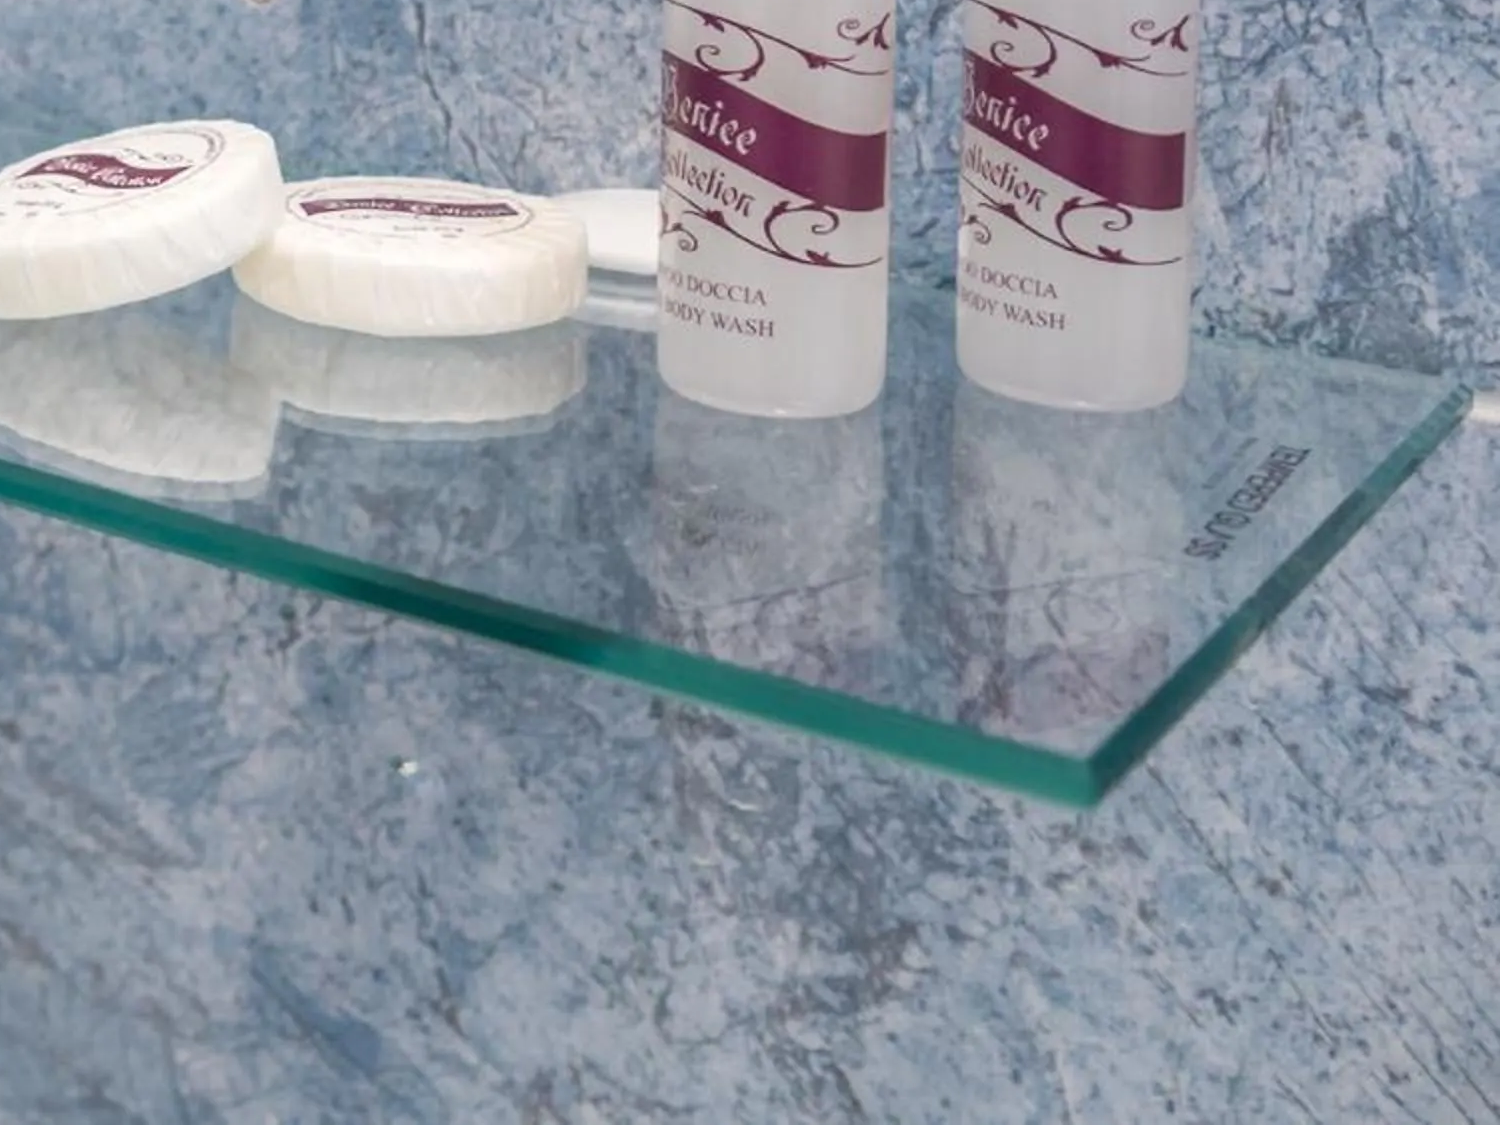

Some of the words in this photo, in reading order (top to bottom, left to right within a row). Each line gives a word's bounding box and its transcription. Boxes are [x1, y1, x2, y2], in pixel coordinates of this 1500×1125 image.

[686, 274, 768, 307] DOCCIA
[980, 265, 1059, 299] DOCCIA
[709, 311, 775, 337] WASH
[1002, 302, 1066, 331] WASH
